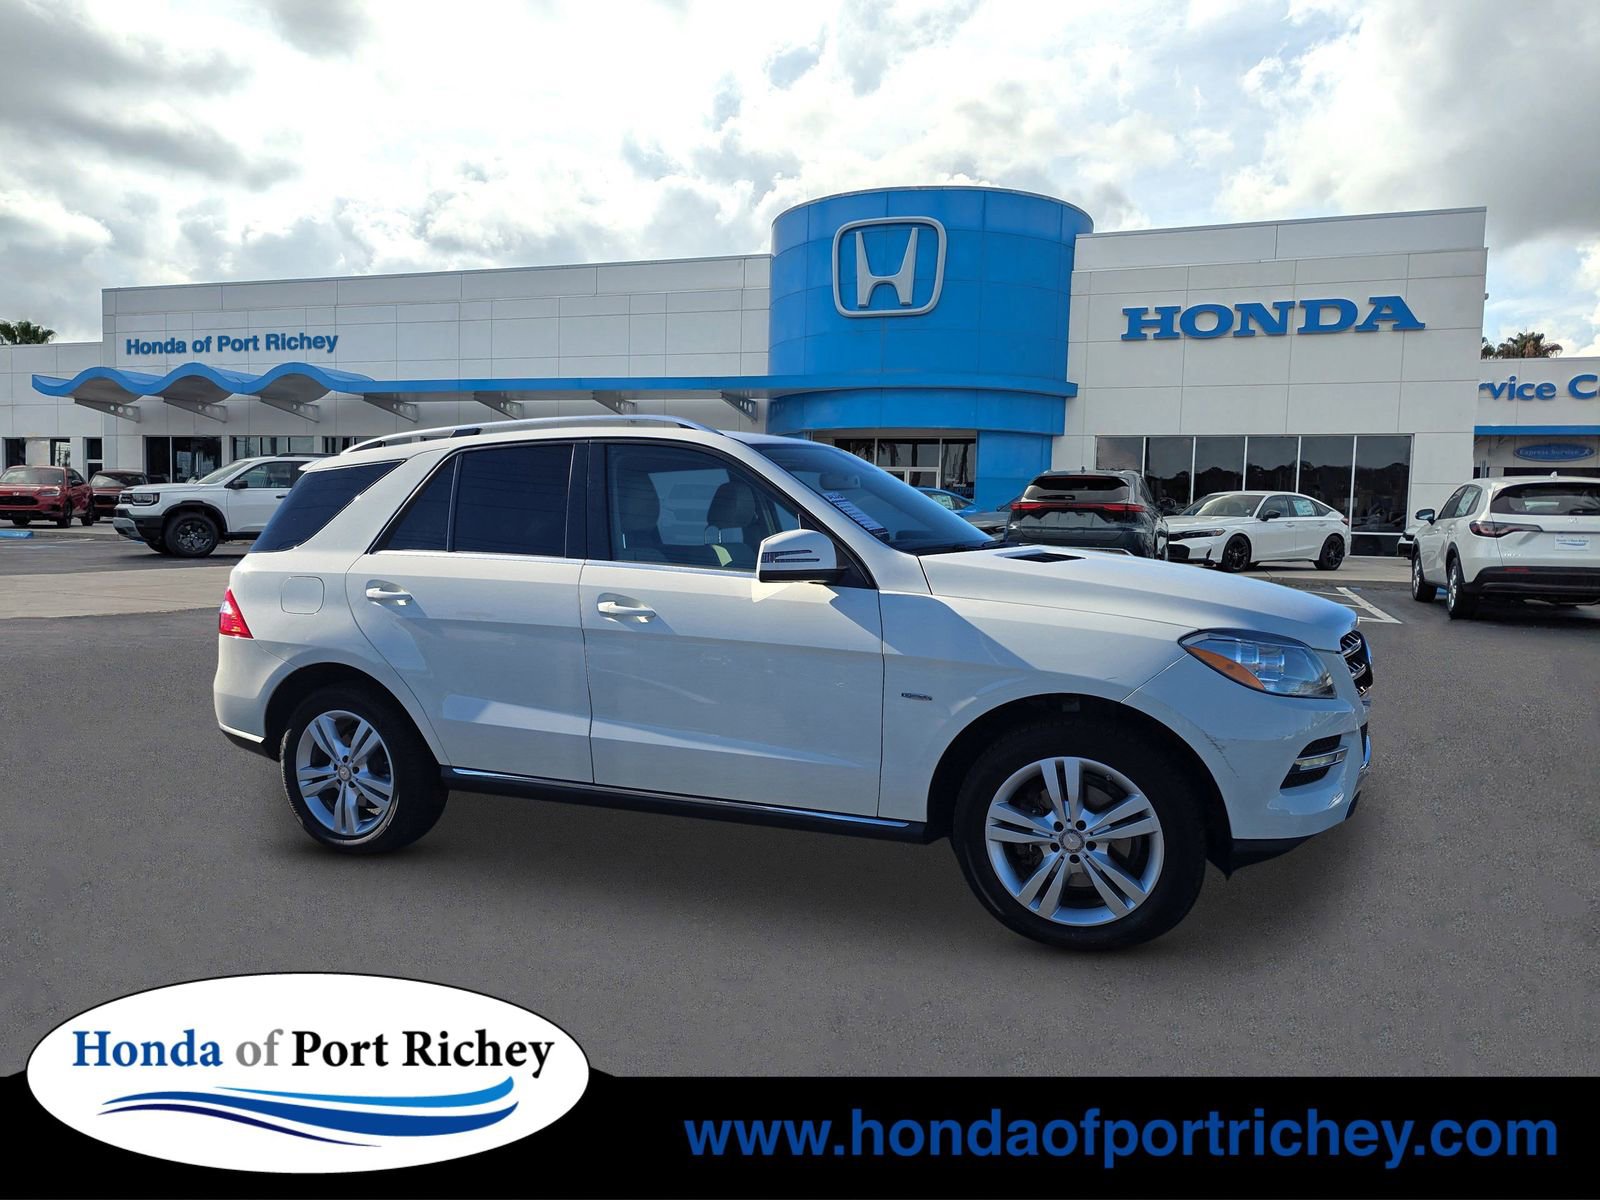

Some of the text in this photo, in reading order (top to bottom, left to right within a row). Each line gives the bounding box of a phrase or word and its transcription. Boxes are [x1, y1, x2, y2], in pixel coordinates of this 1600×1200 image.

[1121, 295, 1426, 341] HONDA
[126, 332, 338, 355] Honda of Port Richey
[1568, 374, 1600, 400] C
